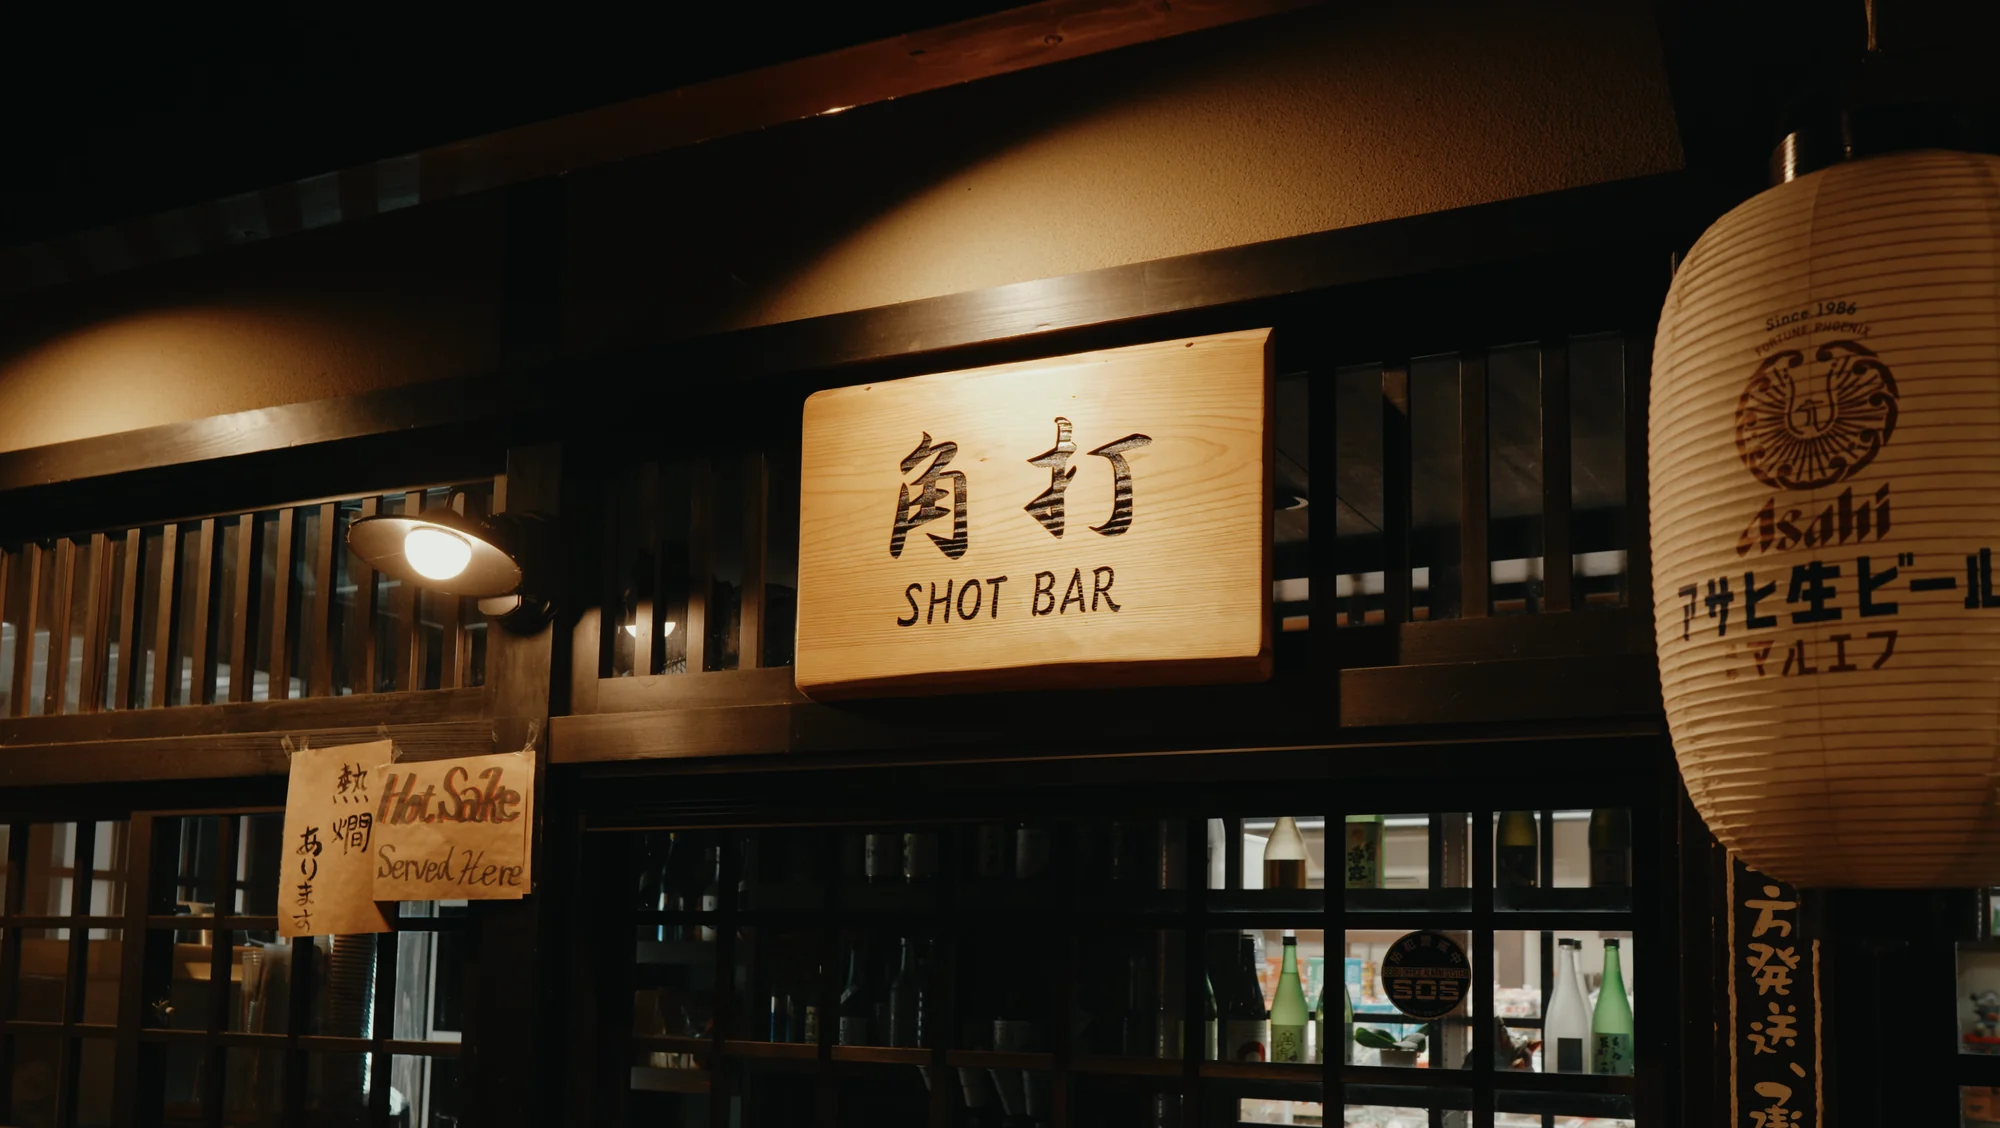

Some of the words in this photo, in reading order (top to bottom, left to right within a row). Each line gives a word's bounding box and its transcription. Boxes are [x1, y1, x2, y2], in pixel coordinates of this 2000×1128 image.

[1755, 324, 1808, 356] FORTUNE
[1815, 321, 1873, 338] PHOENIX
[1766, 309, 1808, 331] Since
[1817, 301, 1857, 317] 1986
[889, 416, 1153, 560] 角打
[1736, 482, 1891, 557] Asahi
[897, 575, 1008, 627] SHOT
[1031, 566, 1121, 616] BAR
[1678, 547, 2000, 641] アサヒ生ビール
[376, 772, 436, 826] Hot
[438, 766, 521, 824] Sake
[292, 826, 323, 932] あります
[377, 844, 455, 883] Served
[457, 849, 523, 886] Here
[1393, 979, 1459, 1001] SOS
